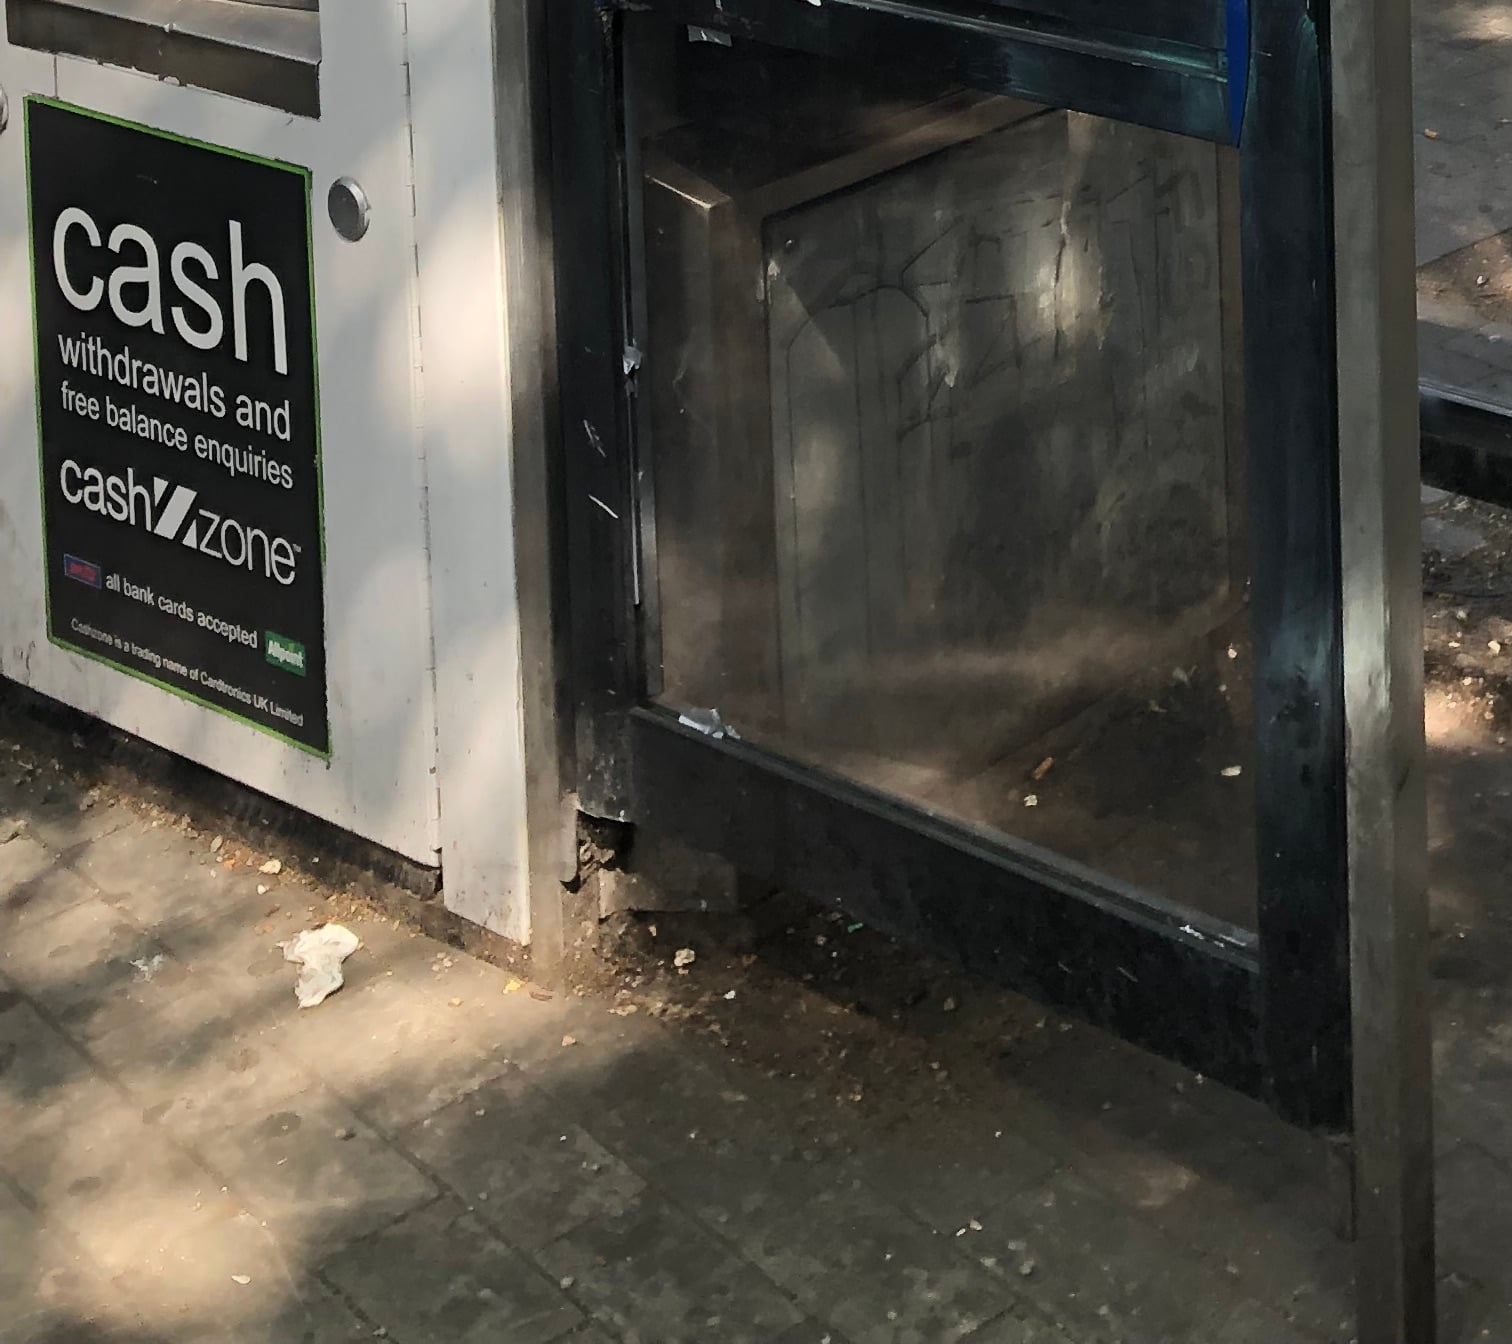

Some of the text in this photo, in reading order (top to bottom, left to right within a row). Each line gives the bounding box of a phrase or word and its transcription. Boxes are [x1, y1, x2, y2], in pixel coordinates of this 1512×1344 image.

[53, 207, 288, 375] cash
[58, 331, 291, 441] withdrawals and
[61, 380, 293, 489] free balance enquiries
[105, 573, 120, 592] all
[123, 578, 155, 606] bank
[158, 594, 194, 622] cards
[197, 611, 258, 649] accepted
[114, 635, 122, 650] is
[124, 641, 130, 653] a
[132, 643, 161, 669] trading
[163, 657, 187, 677] name
[190, 668, 199, 681] of
[200, 671, 251, 705] Cardtronics
[253, 694, 268, 713] UK
[270, 701, 304, 727] Limited
